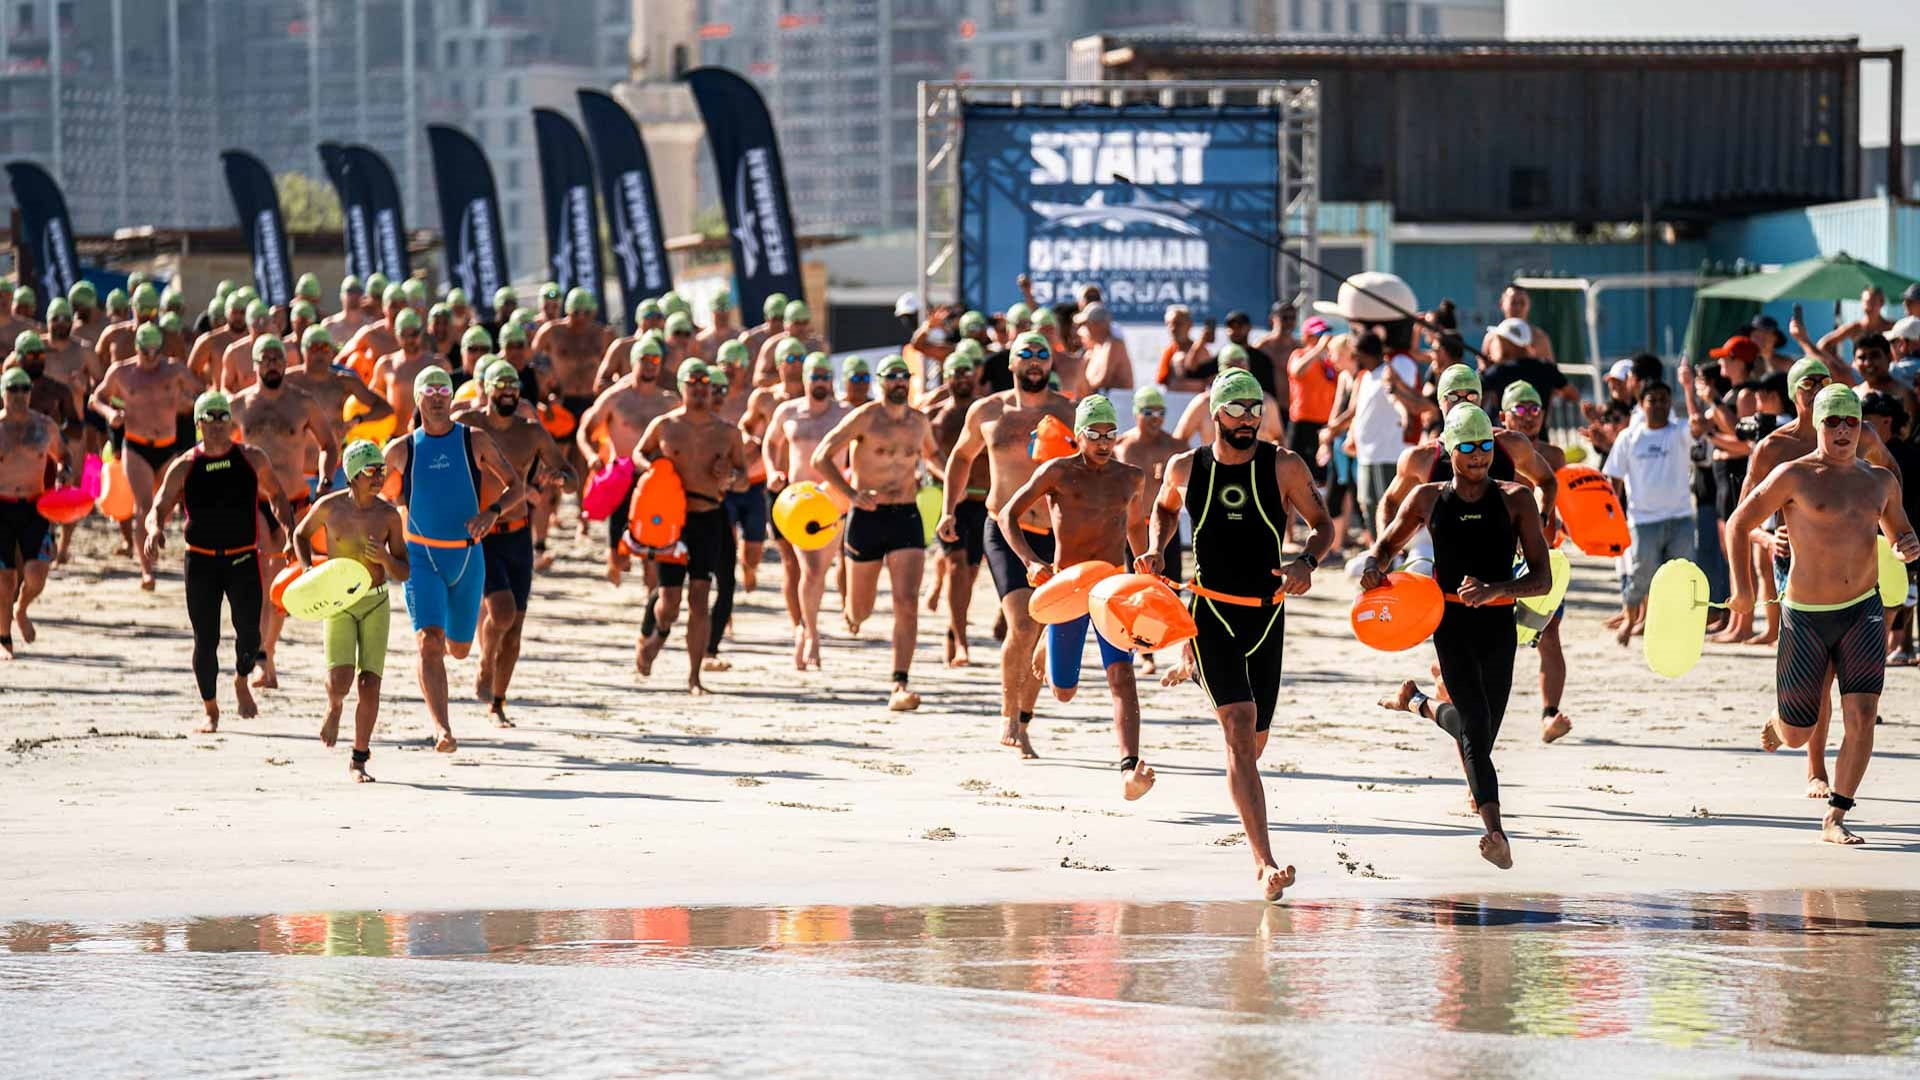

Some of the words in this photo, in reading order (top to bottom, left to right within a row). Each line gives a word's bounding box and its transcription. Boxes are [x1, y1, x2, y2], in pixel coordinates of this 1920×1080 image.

[1031, 131, 1211, 185] START
[746, 148, 788, 275] OCEANMAN
[1031, 240, 1209, 271] OCEANMAN
[1032, 280, 1209, 304] SHRJAH
